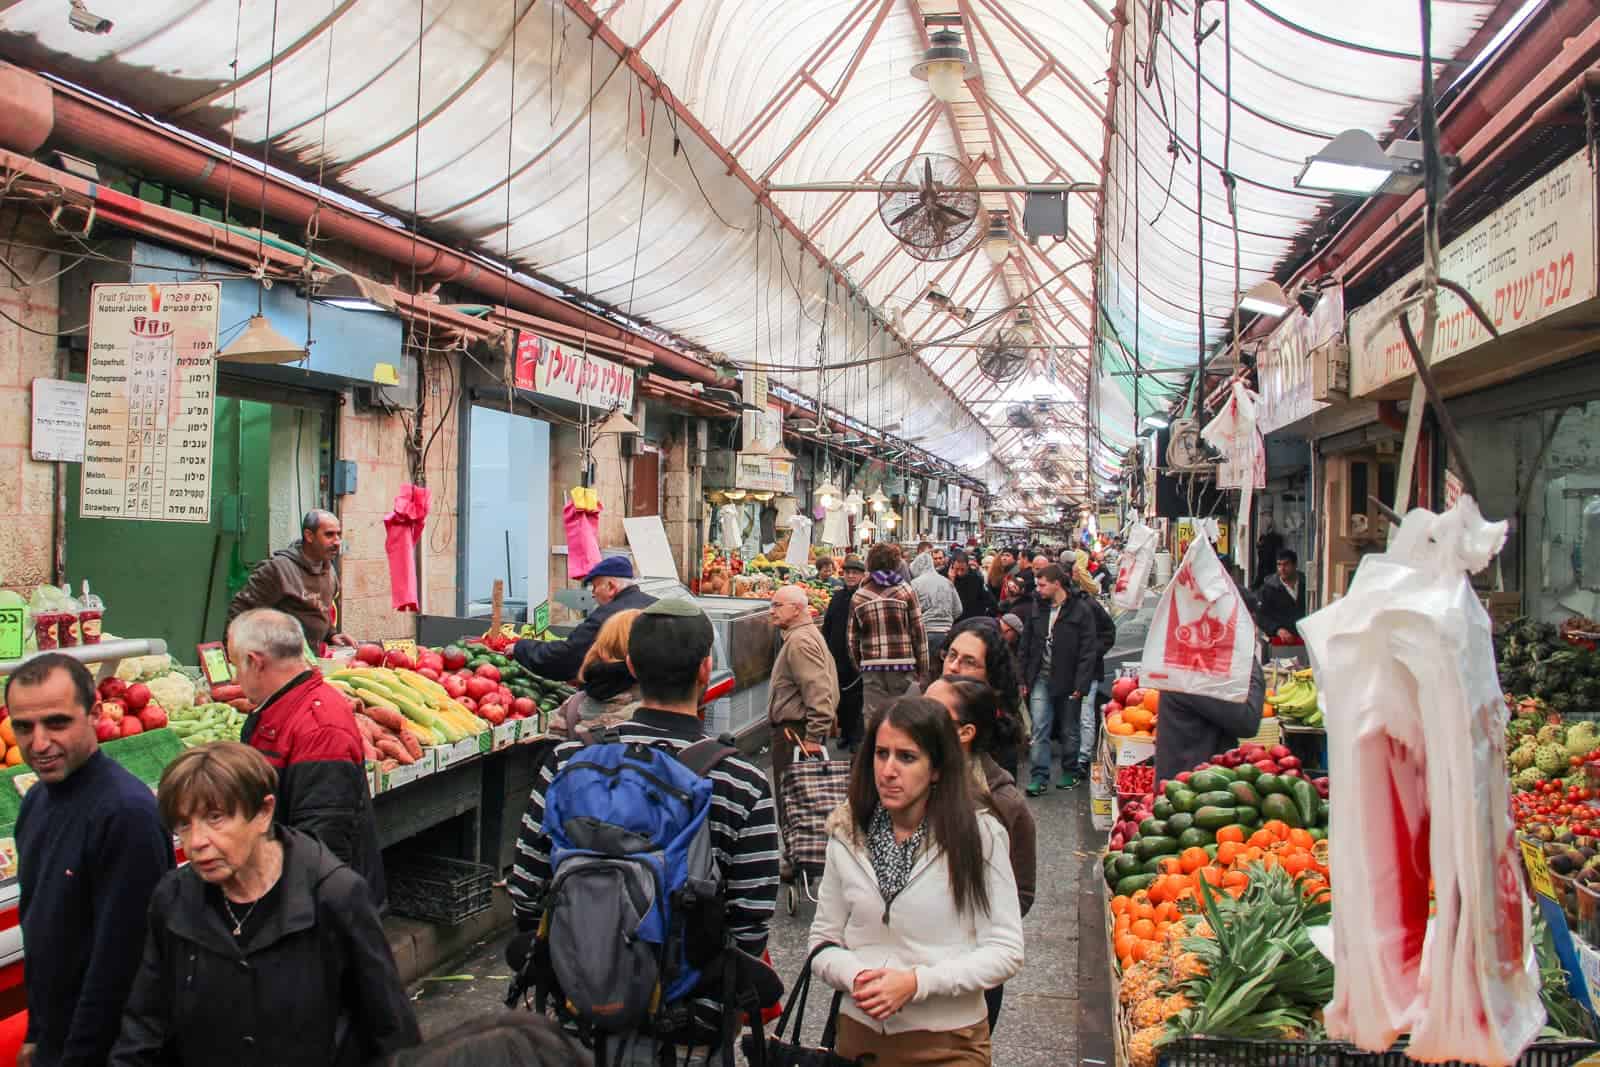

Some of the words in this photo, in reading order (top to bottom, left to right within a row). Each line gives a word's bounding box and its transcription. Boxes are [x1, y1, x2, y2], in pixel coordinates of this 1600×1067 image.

[1495, 251, 1574, 327] מפרישים
[99, 304, 125, 312] Natural
[127, 304, 147, 312] Juice
[93, 342, 115, 350] Orange
[193, 341, 213, 350] תפוז
[92, 356, 125, 366] Grapefruit
[91, 375, 127, 383] Pomegranate
[189, 375, 210, 384] רימון
[601, 362, 633, 401] אטליז
[196, 391, 210, 399] גזר
[89, 407, 109, 415] Apple
[89, 423, 111, 431] Lemon
[187, 423, 208, 432] לימון
[87, 439, 111, 447] Grapes
[182, 439, 207, 448] ענבים
[180, 456, 206, 465] אבטיח
[85, 488, 113, 496] Cocktail
[84, 504, 120, 513] Strawberry
[168, 505, 186, 514] שדה
[189, 505, 204, 514] תות
